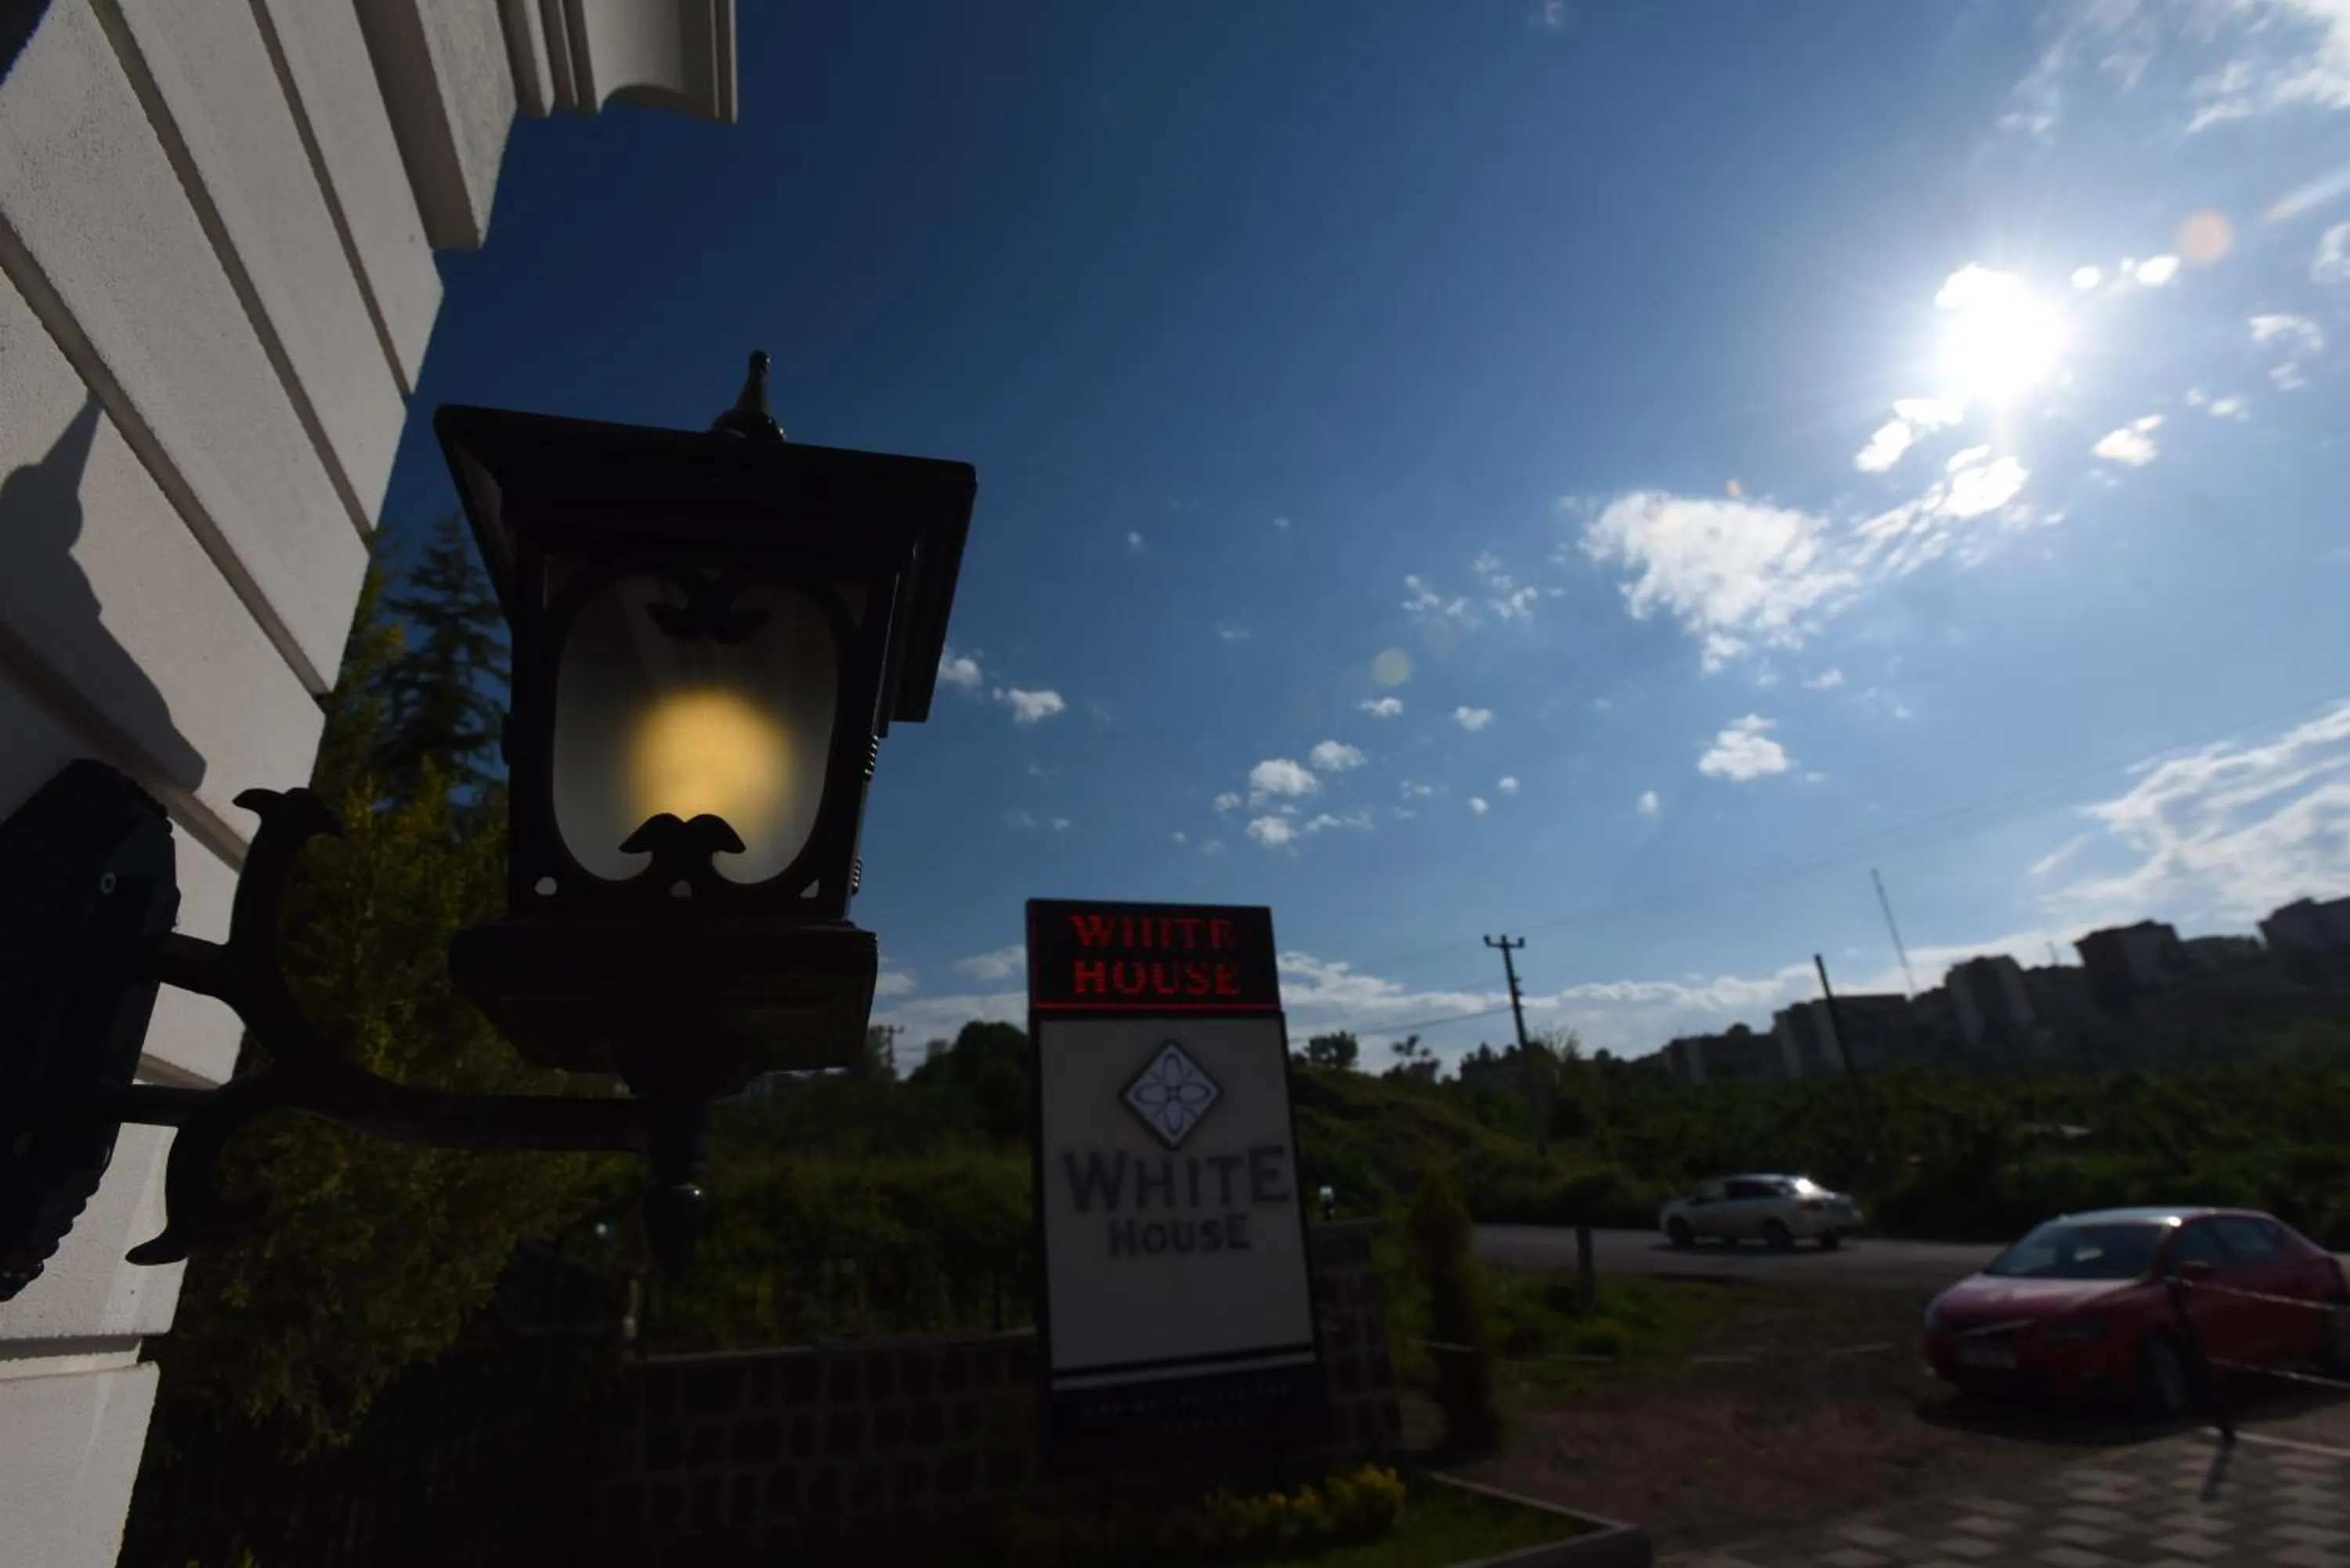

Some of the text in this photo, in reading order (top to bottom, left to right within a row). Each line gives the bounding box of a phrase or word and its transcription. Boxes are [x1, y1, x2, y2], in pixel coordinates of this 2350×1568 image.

[1068, 912, 1238, 951] WHITE
[1072, 959, 1243, 995] HOUSE
[1064, 1144, 1290, 1212] WHITE
[1109, 1213, 1253, 1256] HOUSE
